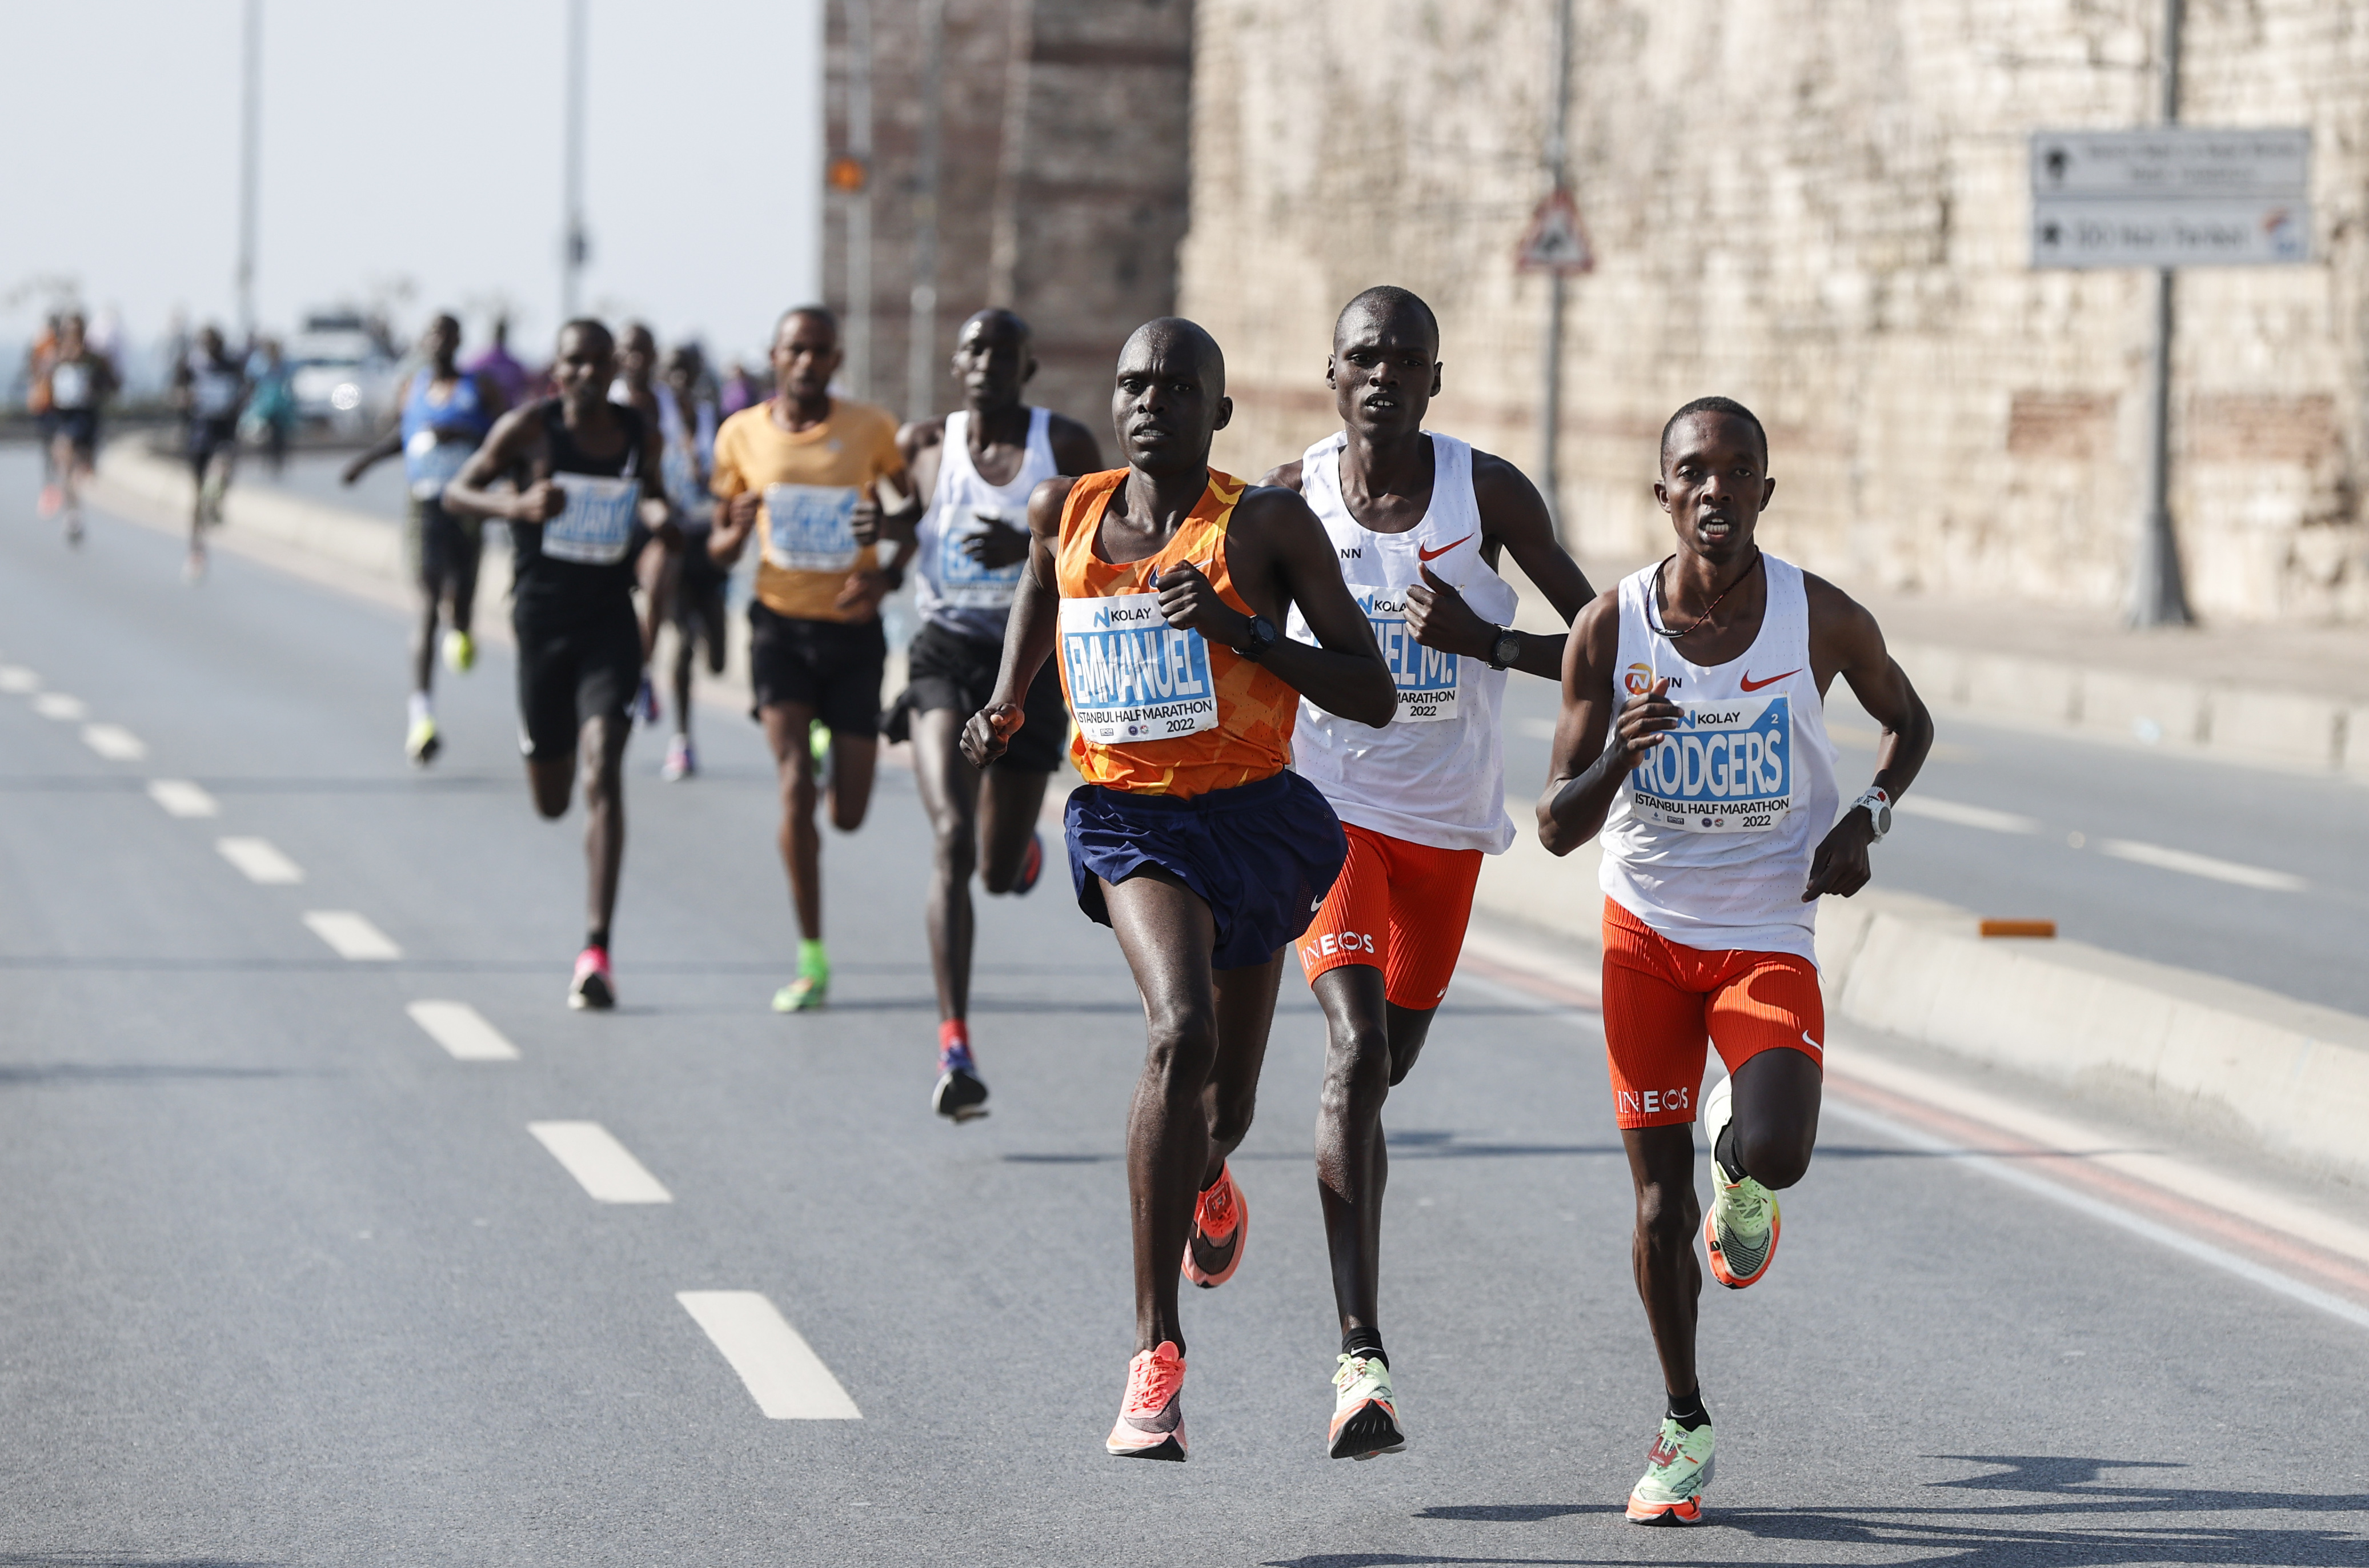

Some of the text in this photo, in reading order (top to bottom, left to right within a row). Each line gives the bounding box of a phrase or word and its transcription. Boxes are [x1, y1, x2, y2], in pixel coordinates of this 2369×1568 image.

[1341, 549, 1361, 559] NN
[1374, 600, 1407, 612] KOLA
[1111, 607, 1151, 622] KOLAY
[1068, 629, 1203, 704] EMMANUEL
[1077, 700, 1213, 724] ISTANBUL HALF MARATHON
[1410, 706, 1437, 717] 2022
[1697, 712, 1740, 724] KOLAY
[1771, 714, 1778, 724] 2
[1167, 717, 1195, 732] 2022
[1638, 729, 1783, 797] RODGERS
[1636, 793, 1789, 815] ISTANBUL HALF MARATHON
[1742, 815, 1771, 827] 2022
[1302, 931, 1374, 970] INEOS
[1618, 1087, 1688, 1113] INEOS
